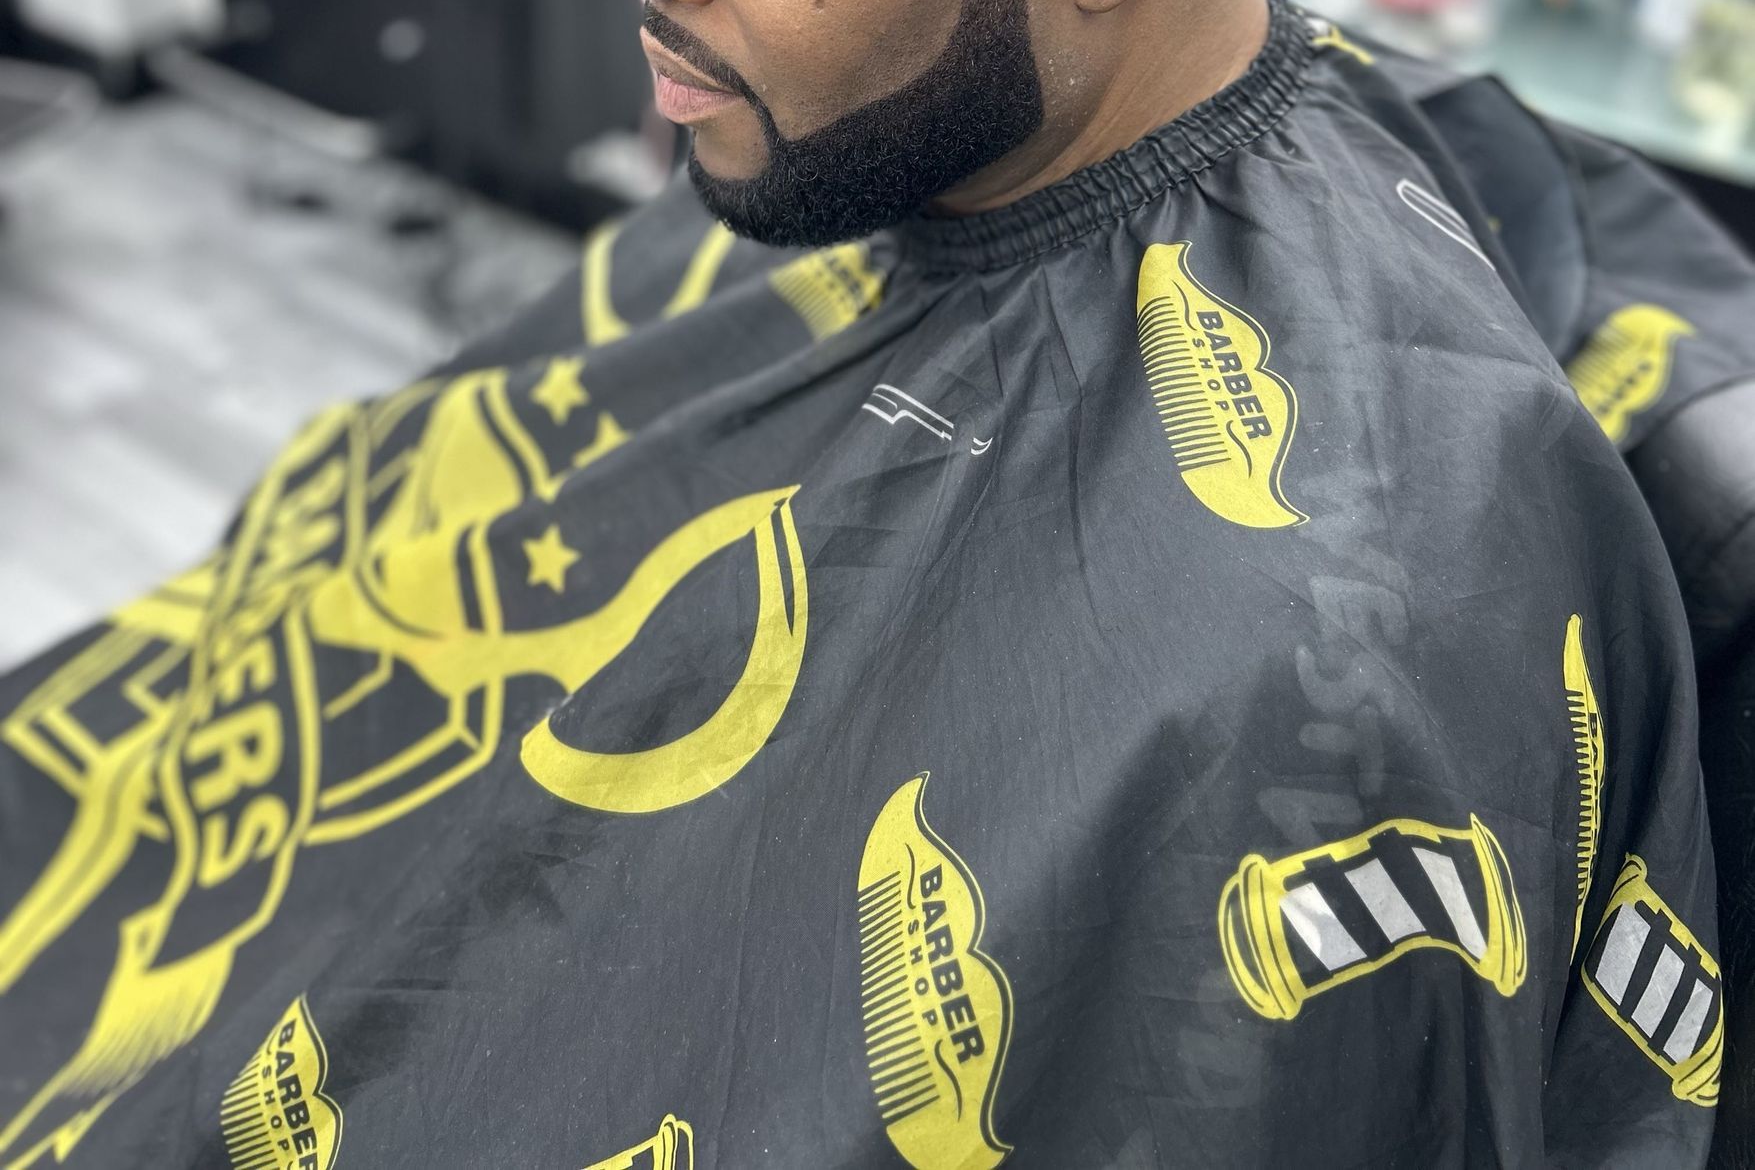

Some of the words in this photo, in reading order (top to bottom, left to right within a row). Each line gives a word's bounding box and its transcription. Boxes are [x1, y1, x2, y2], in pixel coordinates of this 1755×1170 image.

[1192, 337, 1230, 412] SHOP
[1196, 311, 1273, 440] BARBER
[907, 918, 937, 1028] SHOP
[919, 862, 986, 1065] BARBER
[261, 1064, 290, 1152] SHOP
